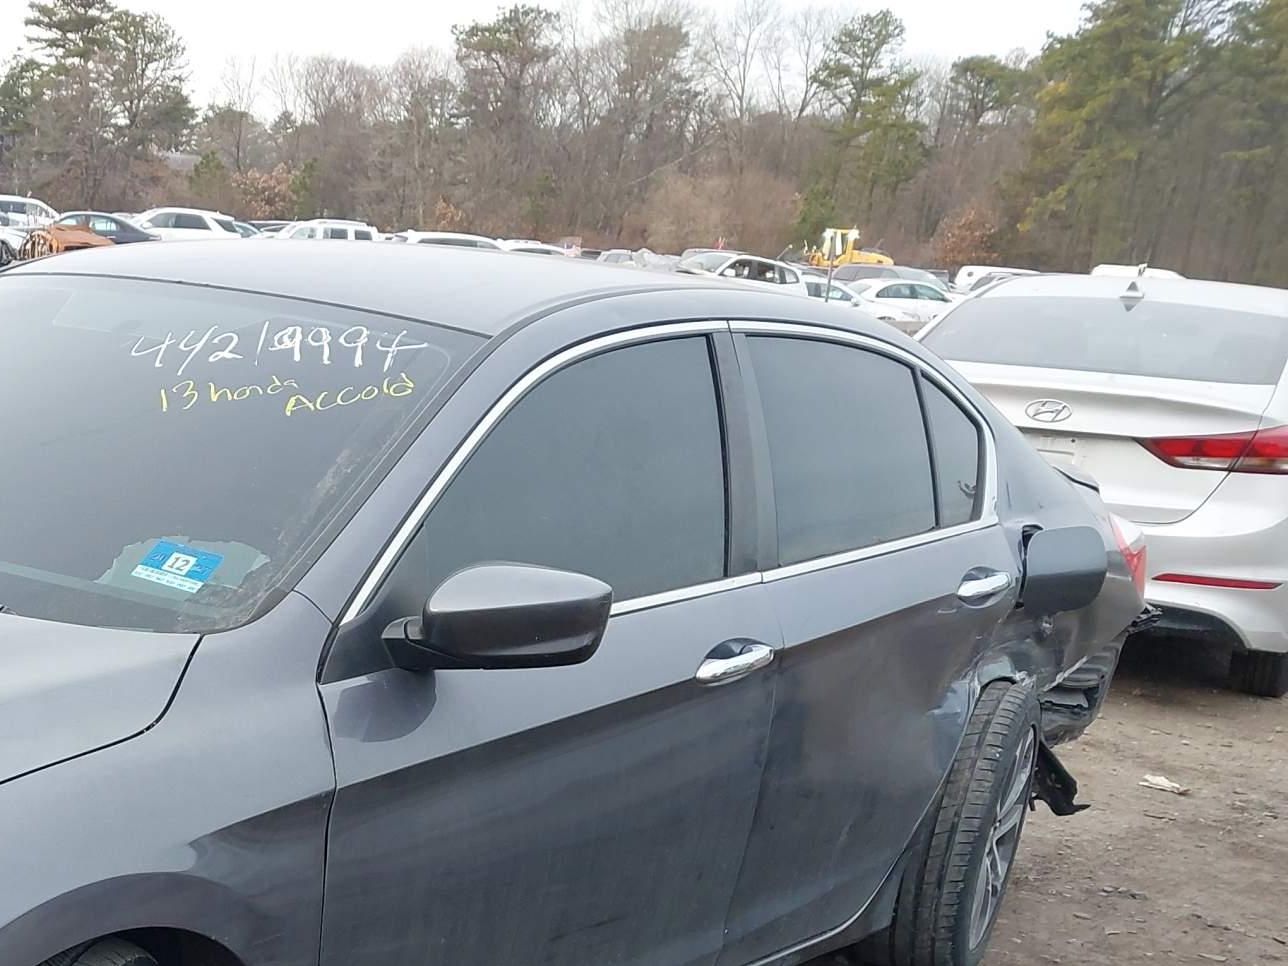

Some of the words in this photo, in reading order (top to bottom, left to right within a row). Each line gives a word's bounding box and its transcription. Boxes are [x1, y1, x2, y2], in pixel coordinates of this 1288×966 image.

[130, 320, 429, 376] 44219994
[161, 380, 198, 412] 13
[167, 556, 191, 572] 12
